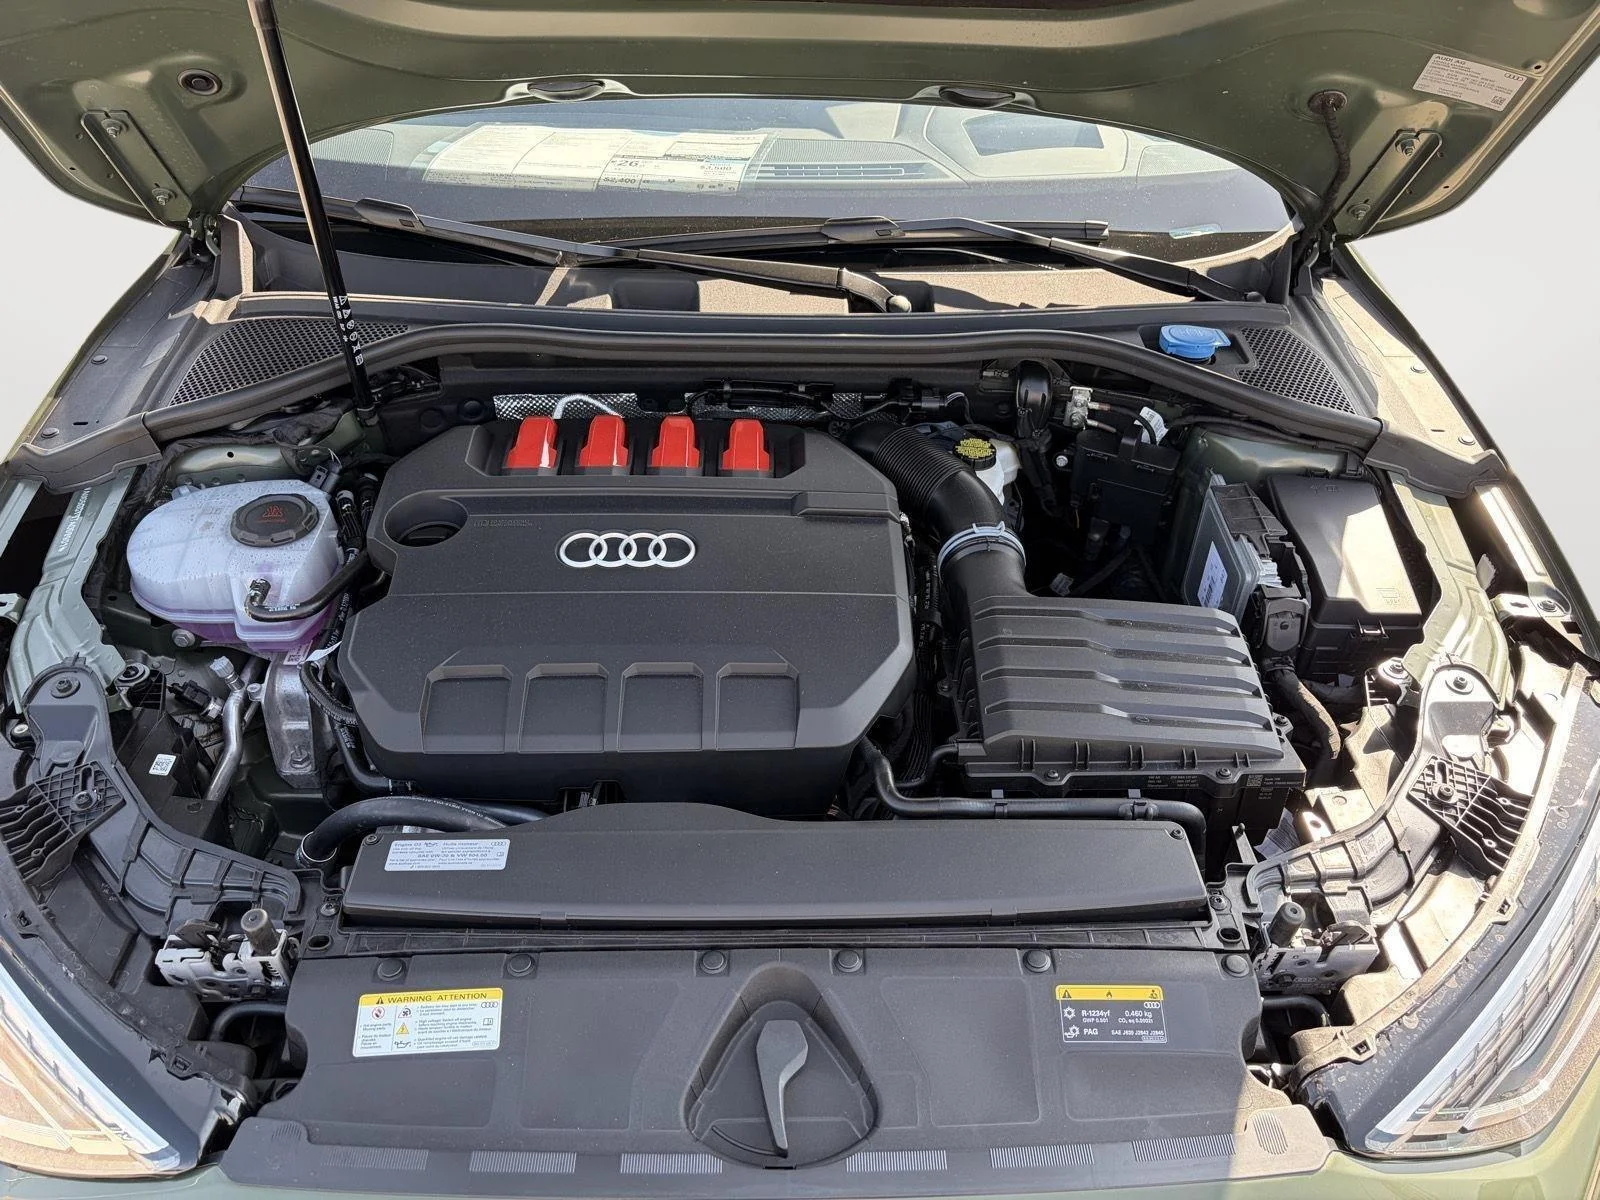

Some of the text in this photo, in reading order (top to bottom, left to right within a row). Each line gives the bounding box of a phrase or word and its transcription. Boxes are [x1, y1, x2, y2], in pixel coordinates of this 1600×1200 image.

[1435, 55, 1454, 63] AUDI
[387, 992, 488, 1004] WARNING ATTENTION
[1081, 1009, 1111, 1018] R-1234yf
[1144, 1010, 1153, 1018] kg
[1083, 1028, 1099, 1036] PAG
